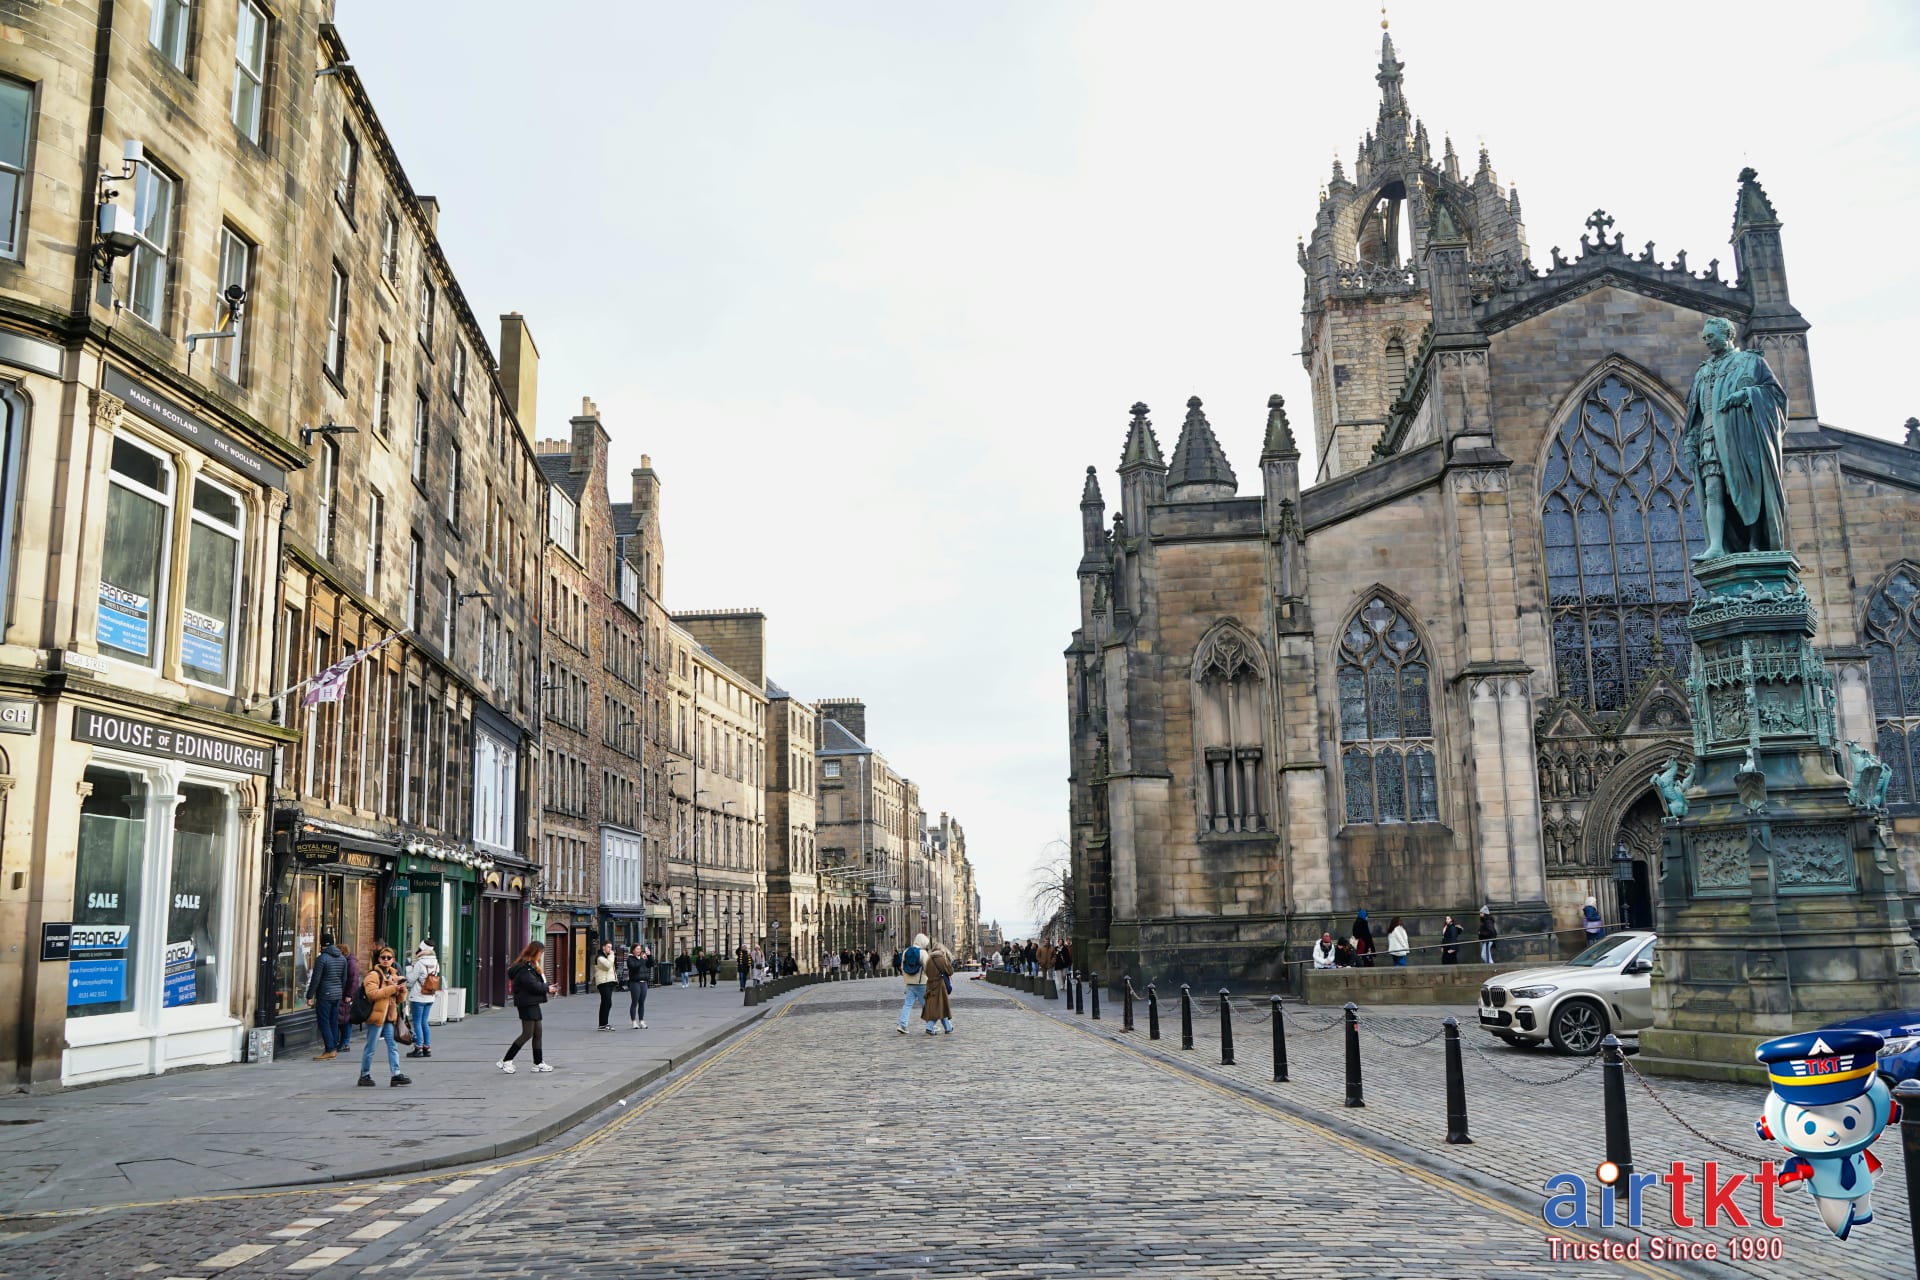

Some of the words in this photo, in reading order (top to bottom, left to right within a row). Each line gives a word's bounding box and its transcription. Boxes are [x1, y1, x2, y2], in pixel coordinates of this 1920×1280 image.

[130, 389, 151, 407] MADE
[153, 402, 160, 412] IN
[162, 408, 198, 434] SCOTLAND
[214, 438, 229, 452] FINE
[230, 447, 262, 471] WOOLLENS
[67, 652, 83, 664] HIGH
[89, 714, 153, 748] HOUSE
[158, 735, 170, 746] OF
[175, 733, 264, 770] EDINBURGH
[297, 843, 320, 851] ROYAL
[321, 843, 338, 852] MILE
[88, 893, 119, 909] SALE
[174, 893, 200, 909] SALE
[72, 931, 122, 948] FRANCEY
[1335, 976, 1350, 988] ST
[1359, 973, 1407, 988] GILES
[1416, 971, 1475, 987] CATHE
